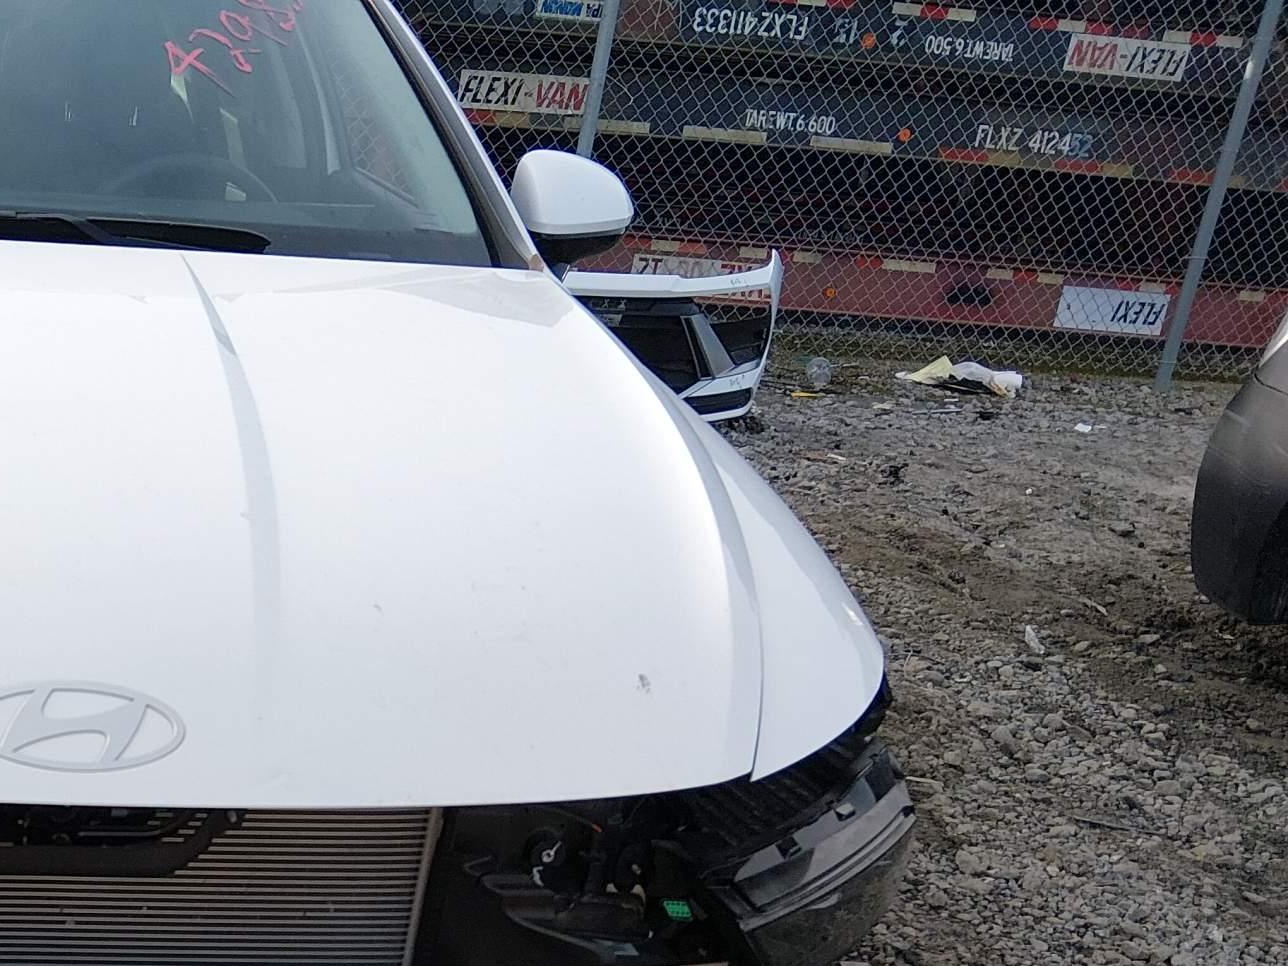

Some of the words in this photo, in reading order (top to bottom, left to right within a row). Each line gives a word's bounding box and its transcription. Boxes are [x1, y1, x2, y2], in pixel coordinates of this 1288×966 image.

[461, 75, 588, 111] FLEXI-VAN
[975, 124, 1024, 151] FLXZ
[1027, 130, 1094, 157] 412452
[1111, 300, 1166, 326] FLEXI
